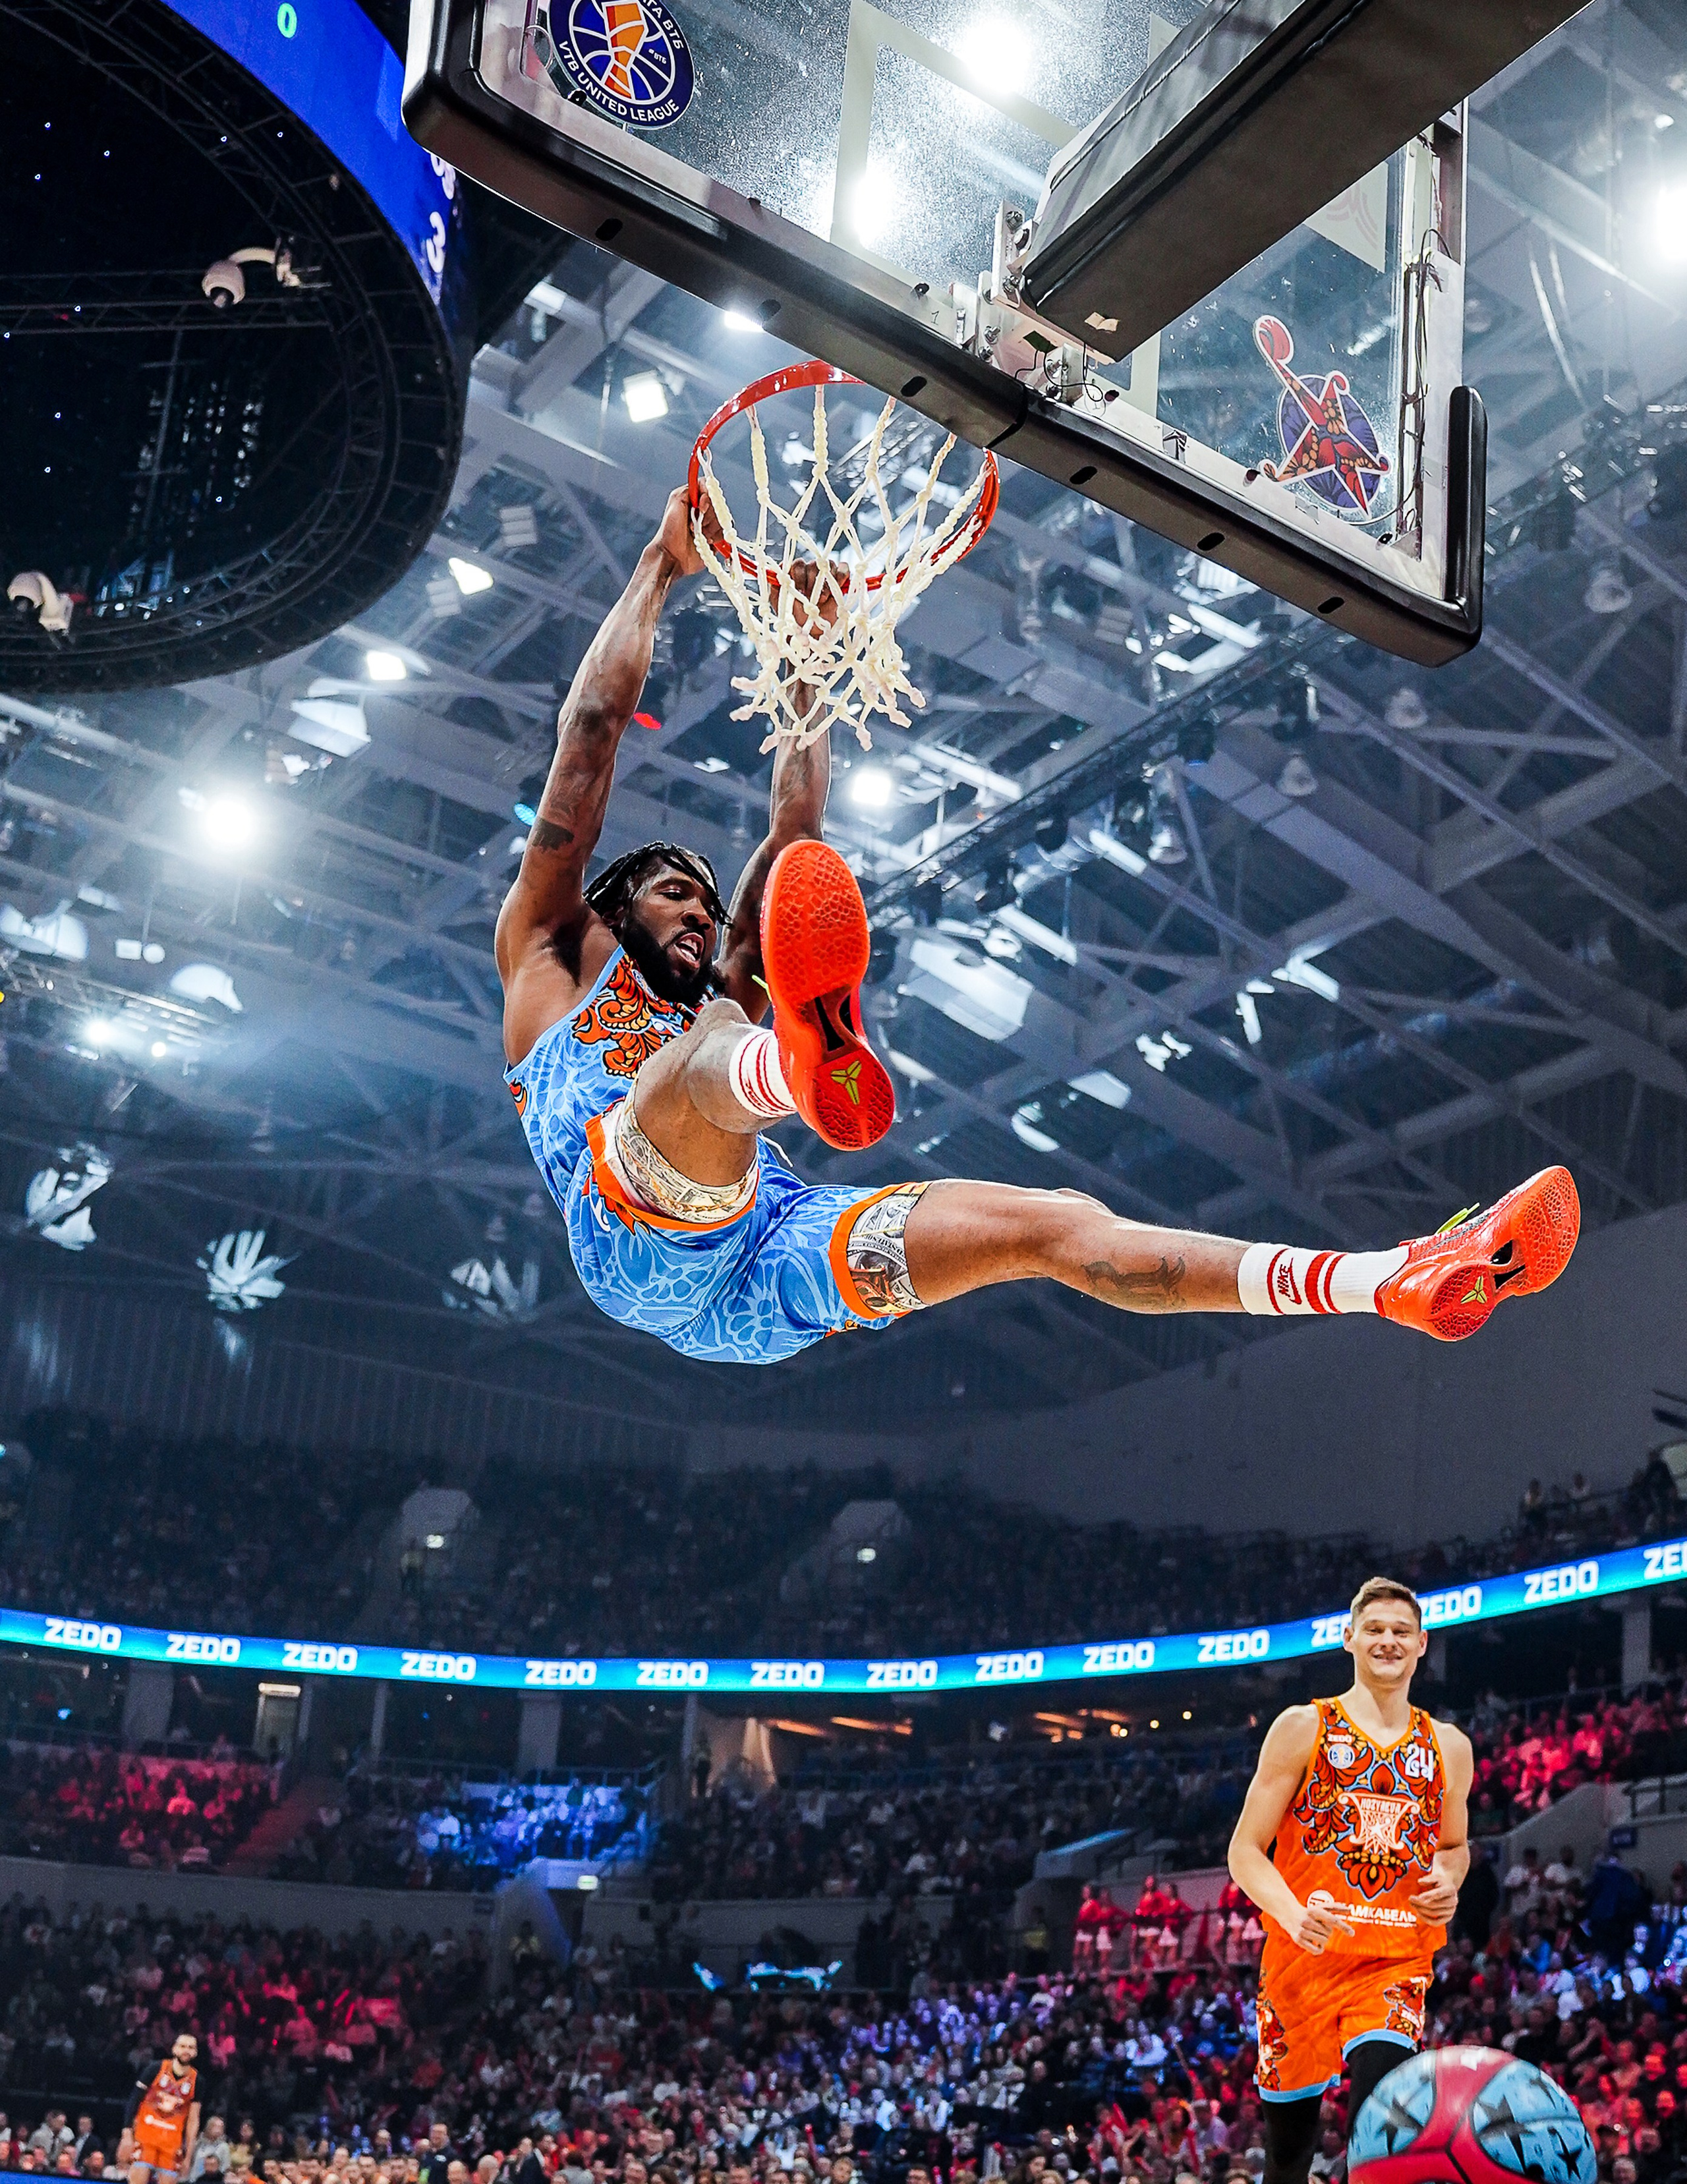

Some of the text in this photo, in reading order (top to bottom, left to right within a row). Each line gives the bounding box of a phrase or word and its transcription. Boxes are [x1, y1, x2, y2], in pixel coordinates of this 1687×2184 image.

[643, 0, 684, 49] ГА ВТБ
[654, 53, 667, 65] ВТБ
[559, 41, 679, 122] VTB UNITED LEAGUE
[1277, 1263, 1290, 1298] NIKE
[1525, 1562, 1598, 1603] ZEDO
[45, 1619, 121, 1650] ZEDO
[1311, 1613, 1351, 1647] ZE
[166, 1634, 240, 1661] ZEDO
[283, 1644, 357, 1671] ZEDO
[1083, 1642, 1154, 1672] ZEDO
[1198, 1630, 1269, 1661] ZEDO
[401, 1653, 476, 1680] ZEDO
[526, 1661, 596, 1684] ZEDO
[637, 1662, 708, 1686] ZEDO
[751, 1663, 824, 1687] ZEDO
[867, 1661, 937, 1687] ZEDO
[976, 1652, 1043, 1681] ZEDO
[1405, 1743, 1434, 1782] 24
[1342, 1903, 1417, 1923] АМКАБЕЛЬ
